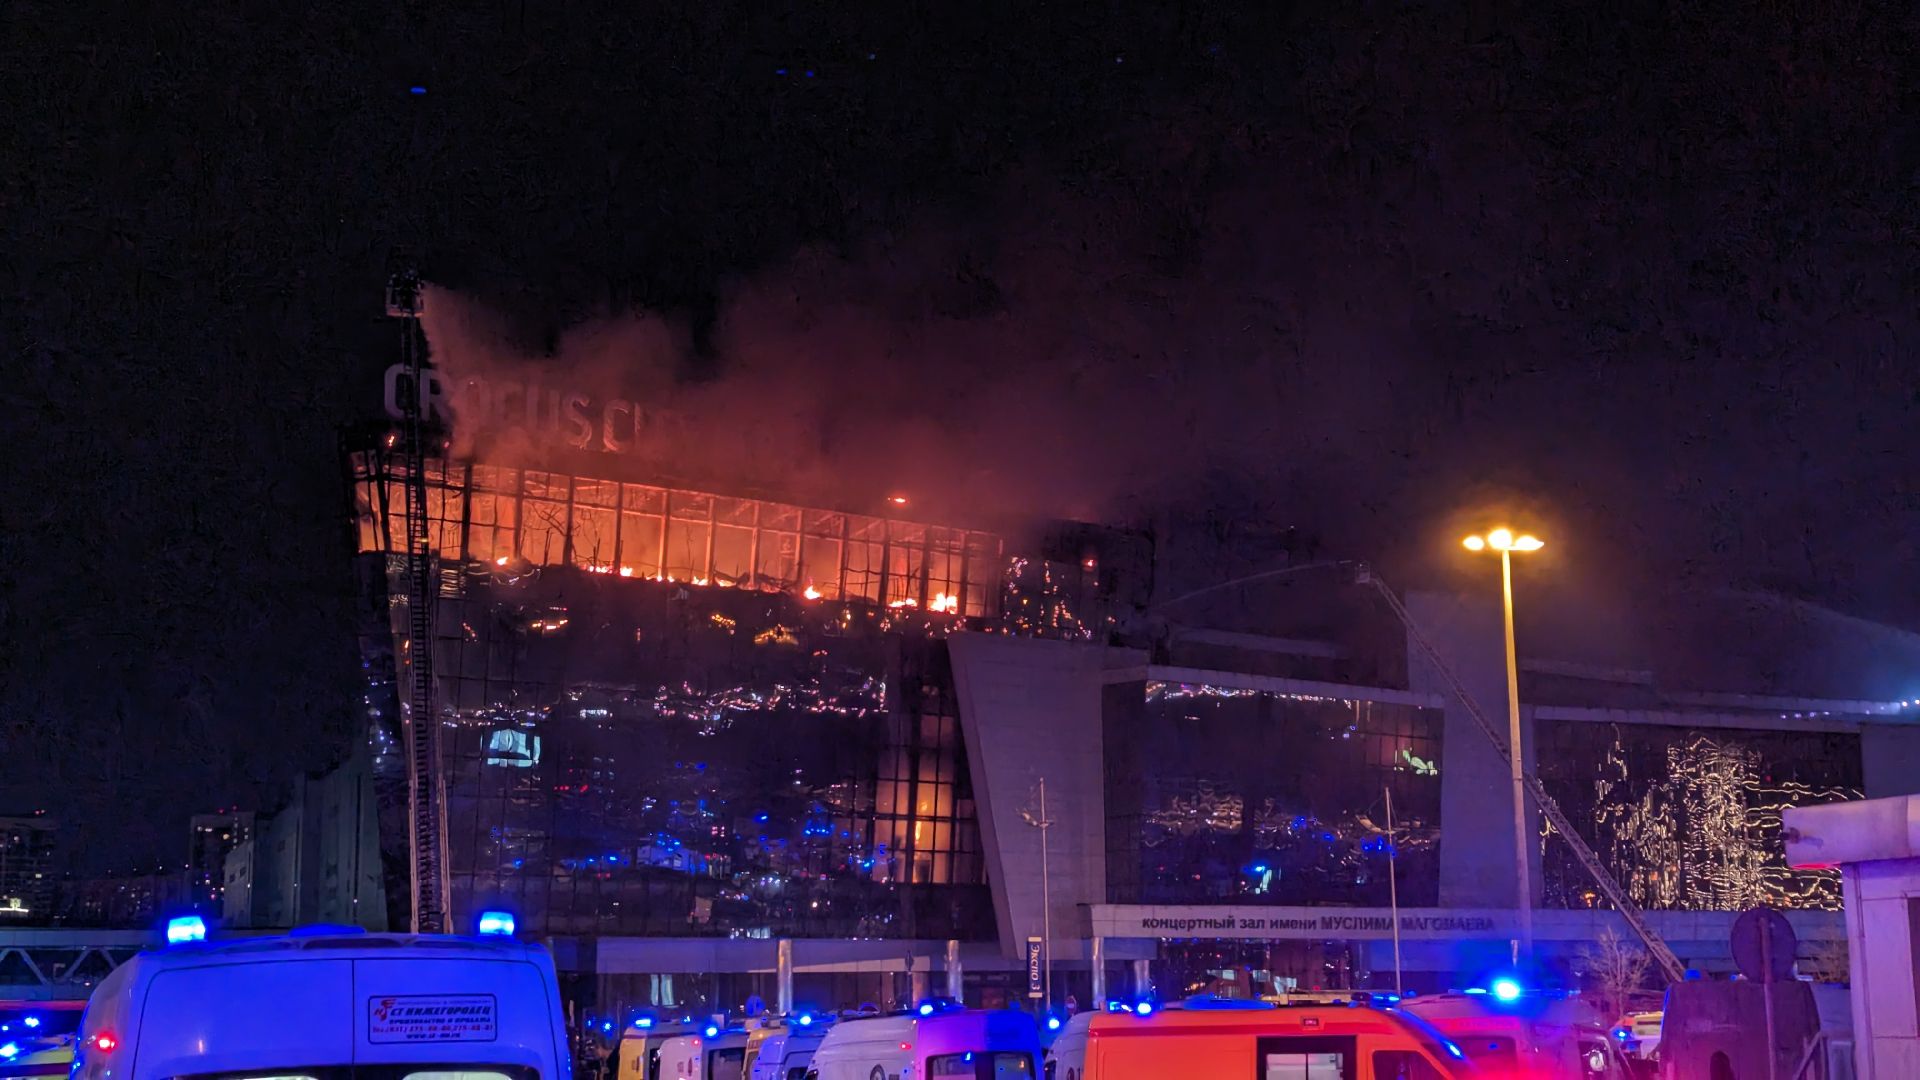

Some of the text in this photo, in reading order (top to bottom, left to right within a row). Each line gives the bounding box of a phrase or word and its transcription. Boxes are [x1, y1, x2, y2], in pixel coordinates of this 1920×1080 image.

[1142, 915, 1236, 932] концертный
[1239, 917, 1265, 929] зал
[1269, 919, 1317, 930] имени
[1321, 916, 1395, 930] МУСЛИМА
[1031, 944, 1040, 981] Экспо
